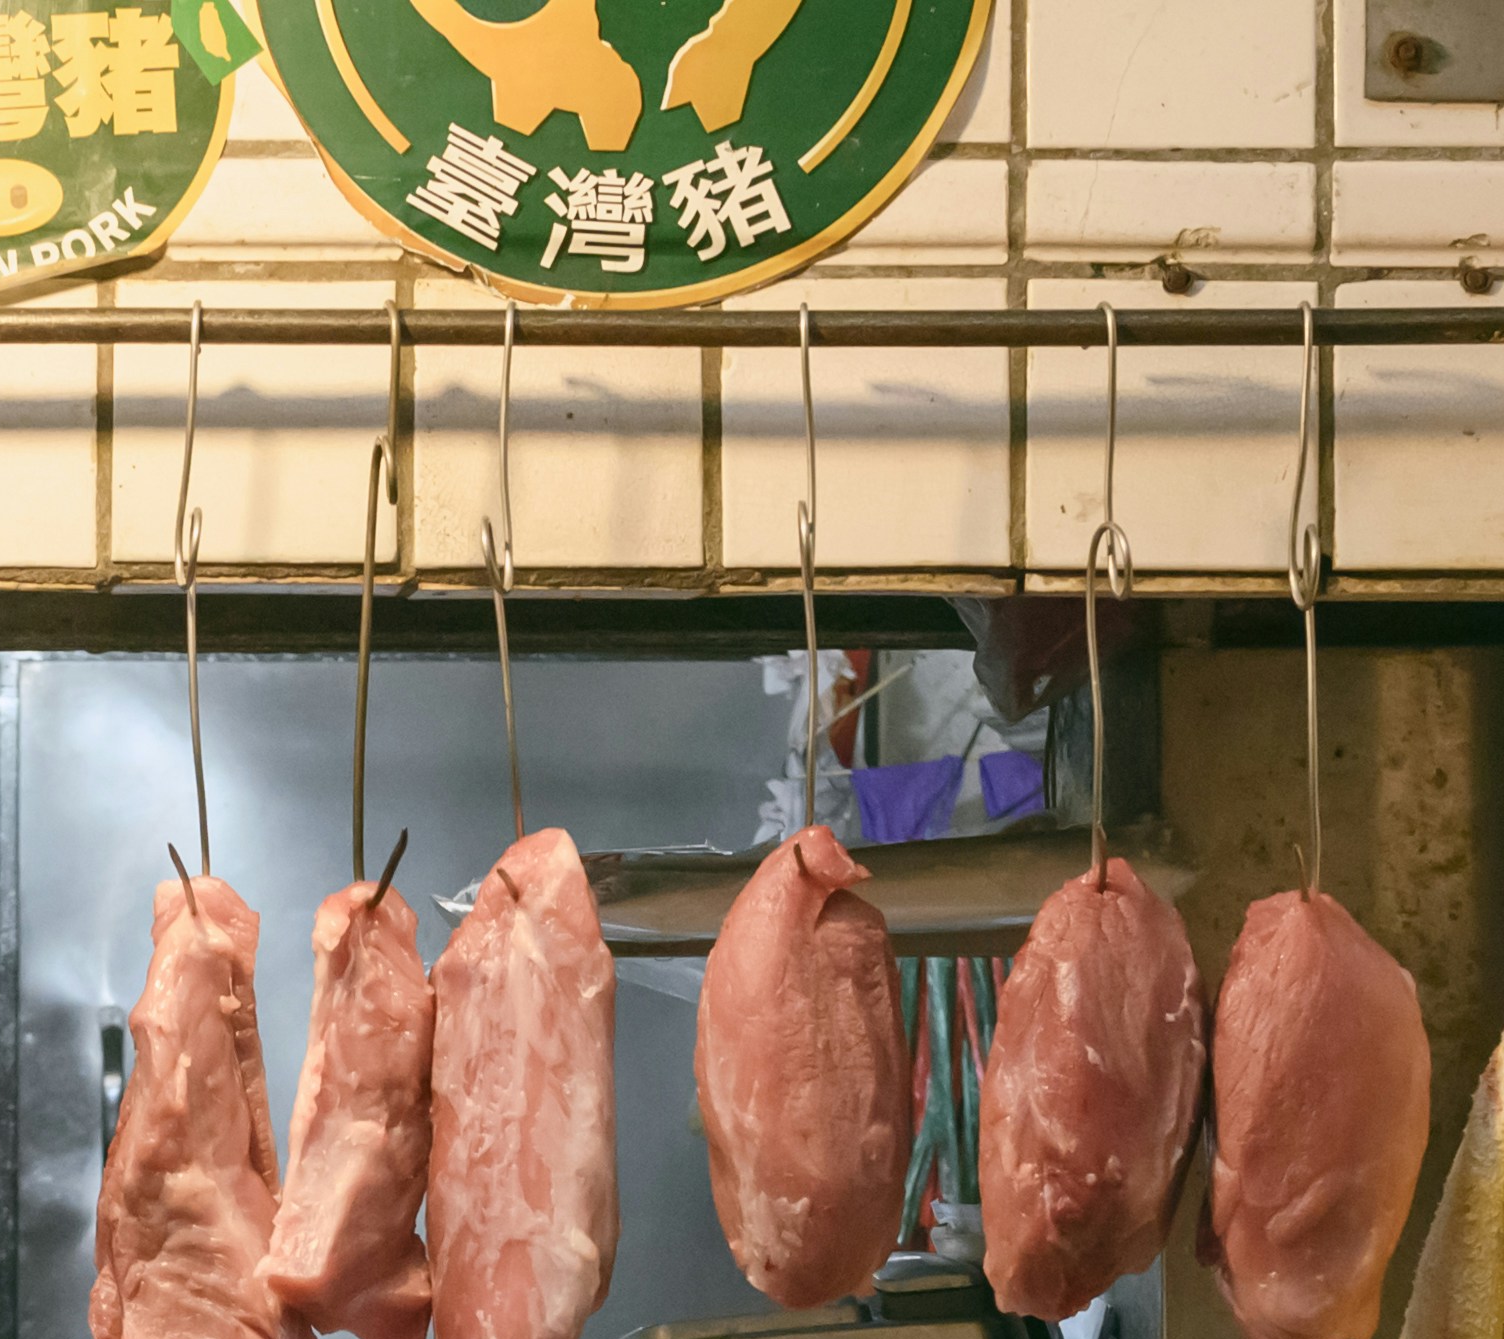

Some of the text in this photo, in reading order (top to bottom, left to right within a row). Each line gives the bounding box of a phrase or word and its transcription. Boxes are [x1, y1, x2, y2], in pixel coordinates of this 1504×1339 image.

[30, 185, 157, 267] PORK
[405, 121, 792, 274] 臺灣豬
